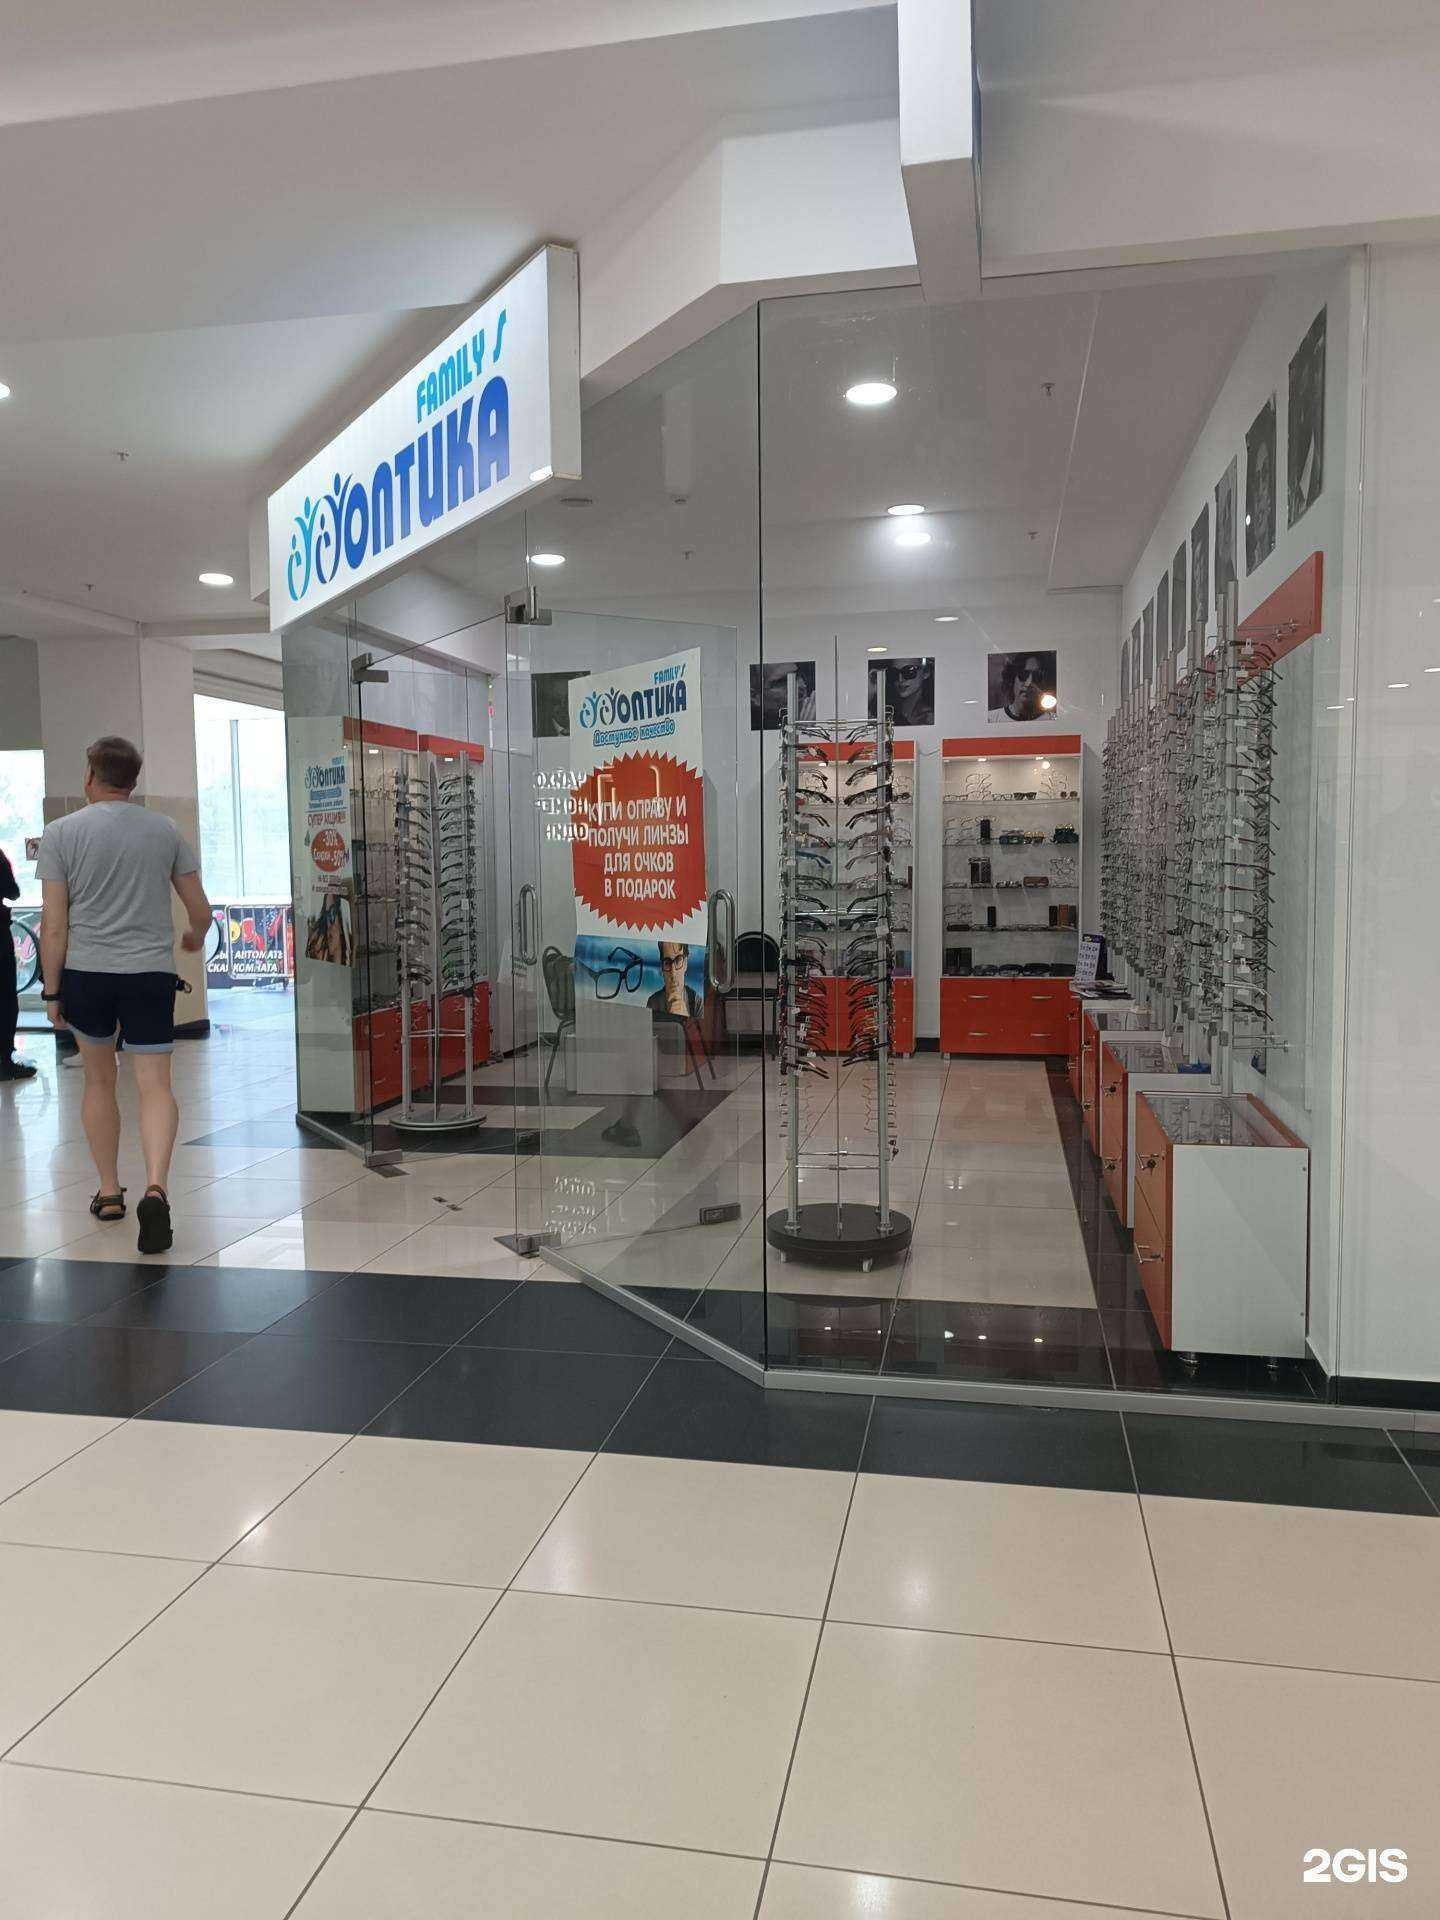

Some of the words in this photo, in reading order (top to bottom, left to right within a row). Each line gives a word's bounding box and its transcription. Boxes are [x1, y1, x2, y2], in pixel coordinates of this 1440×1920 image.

[616, 680, 687, 724] ОПТИКА
[594, 729, 640, 748] Доступное
[639, 718, 676, 740] качество
[589, 801, 622, 822] КУПИ
[627, 797, 671, 821] ОПРАВУ
[676, 795, 687, 817] И
[588, 825, 639, 850] ПОЛУЧИ
[643, 822, 689, 846] ЛИНЗЫ
[604, 852, 631, 874] ДЛЯ
[634, 851, 675, 873] ОЧКОВ
[604, 878, 613, 897] В
[616, 877, 677, 900] ПОДАРОК
